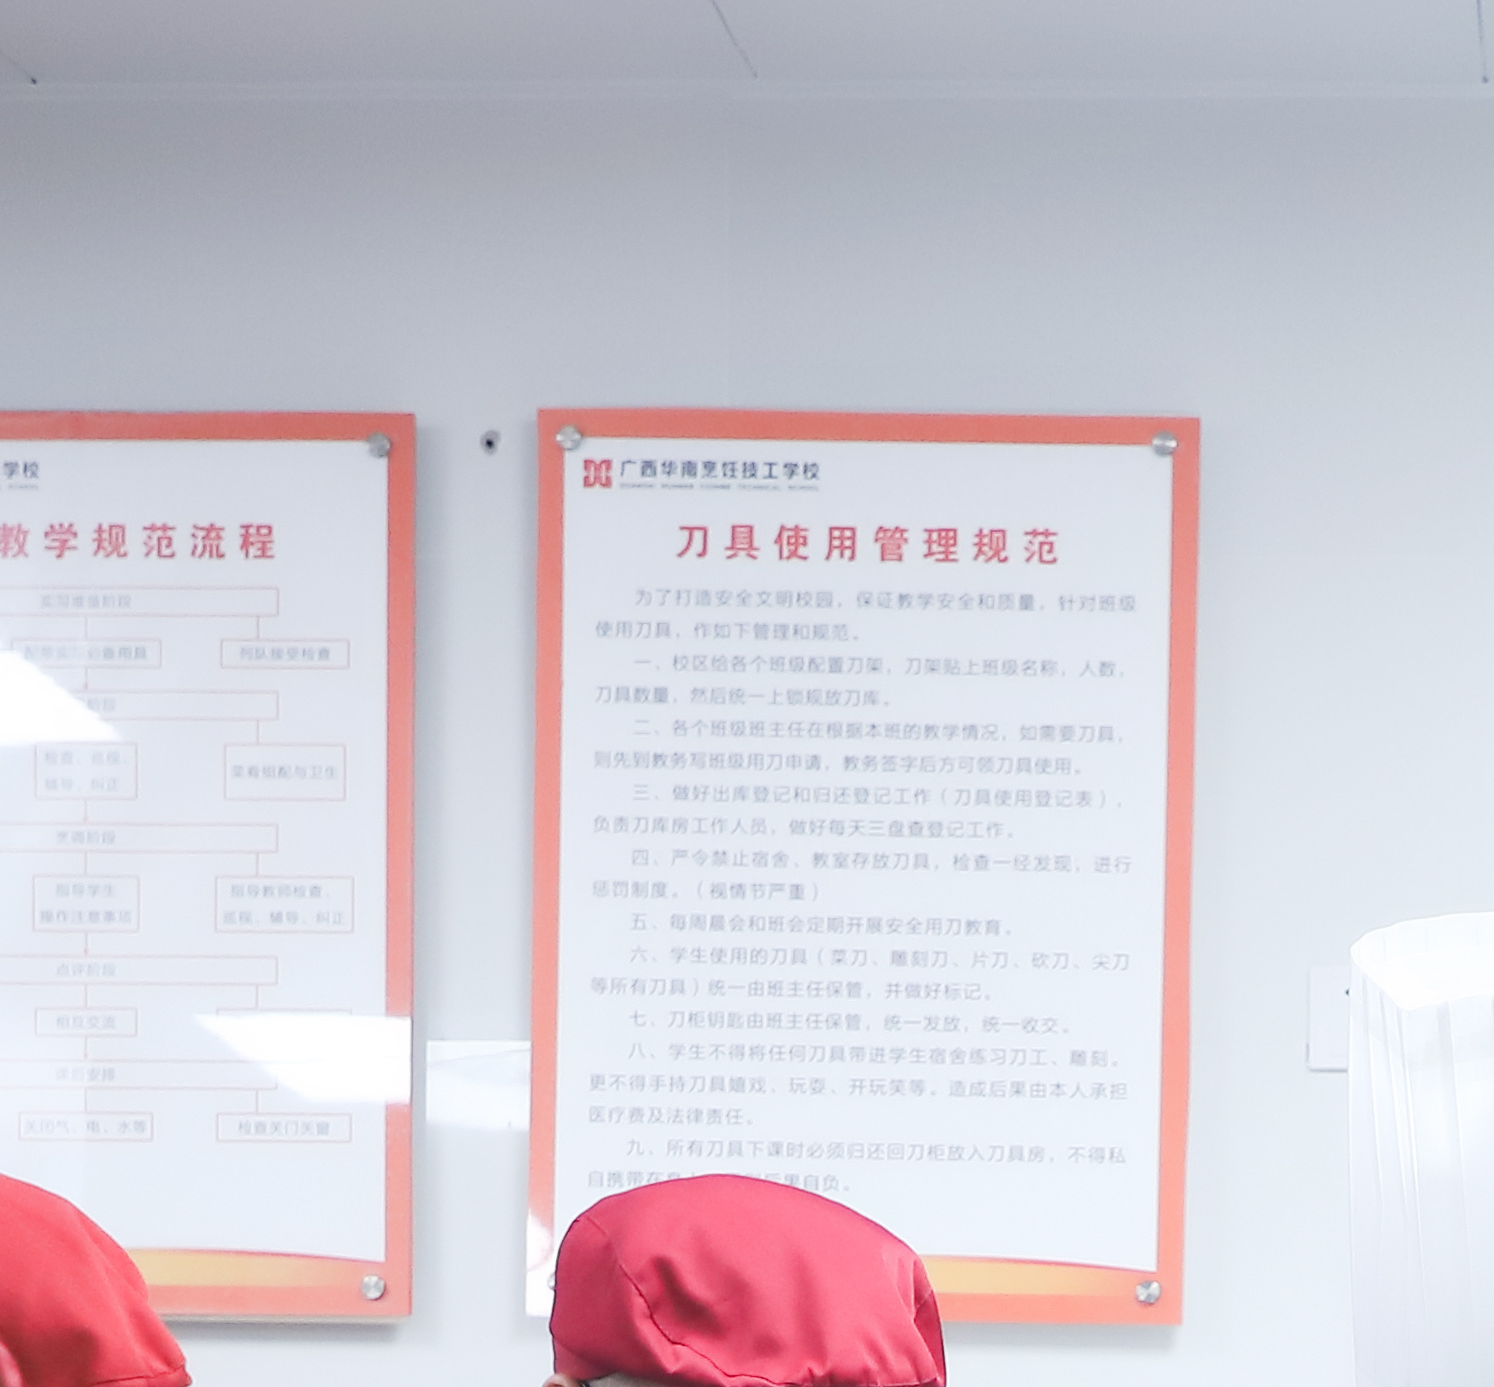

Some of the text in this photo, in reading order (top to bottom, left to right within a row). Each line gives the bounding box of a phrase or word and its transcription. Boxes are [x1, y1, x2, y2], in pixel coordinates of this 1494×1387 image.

[620, 459, 820, 480] 广西华南烹饪技工学校
[677, 524, 1059, 564] 刀具使用管理规范
